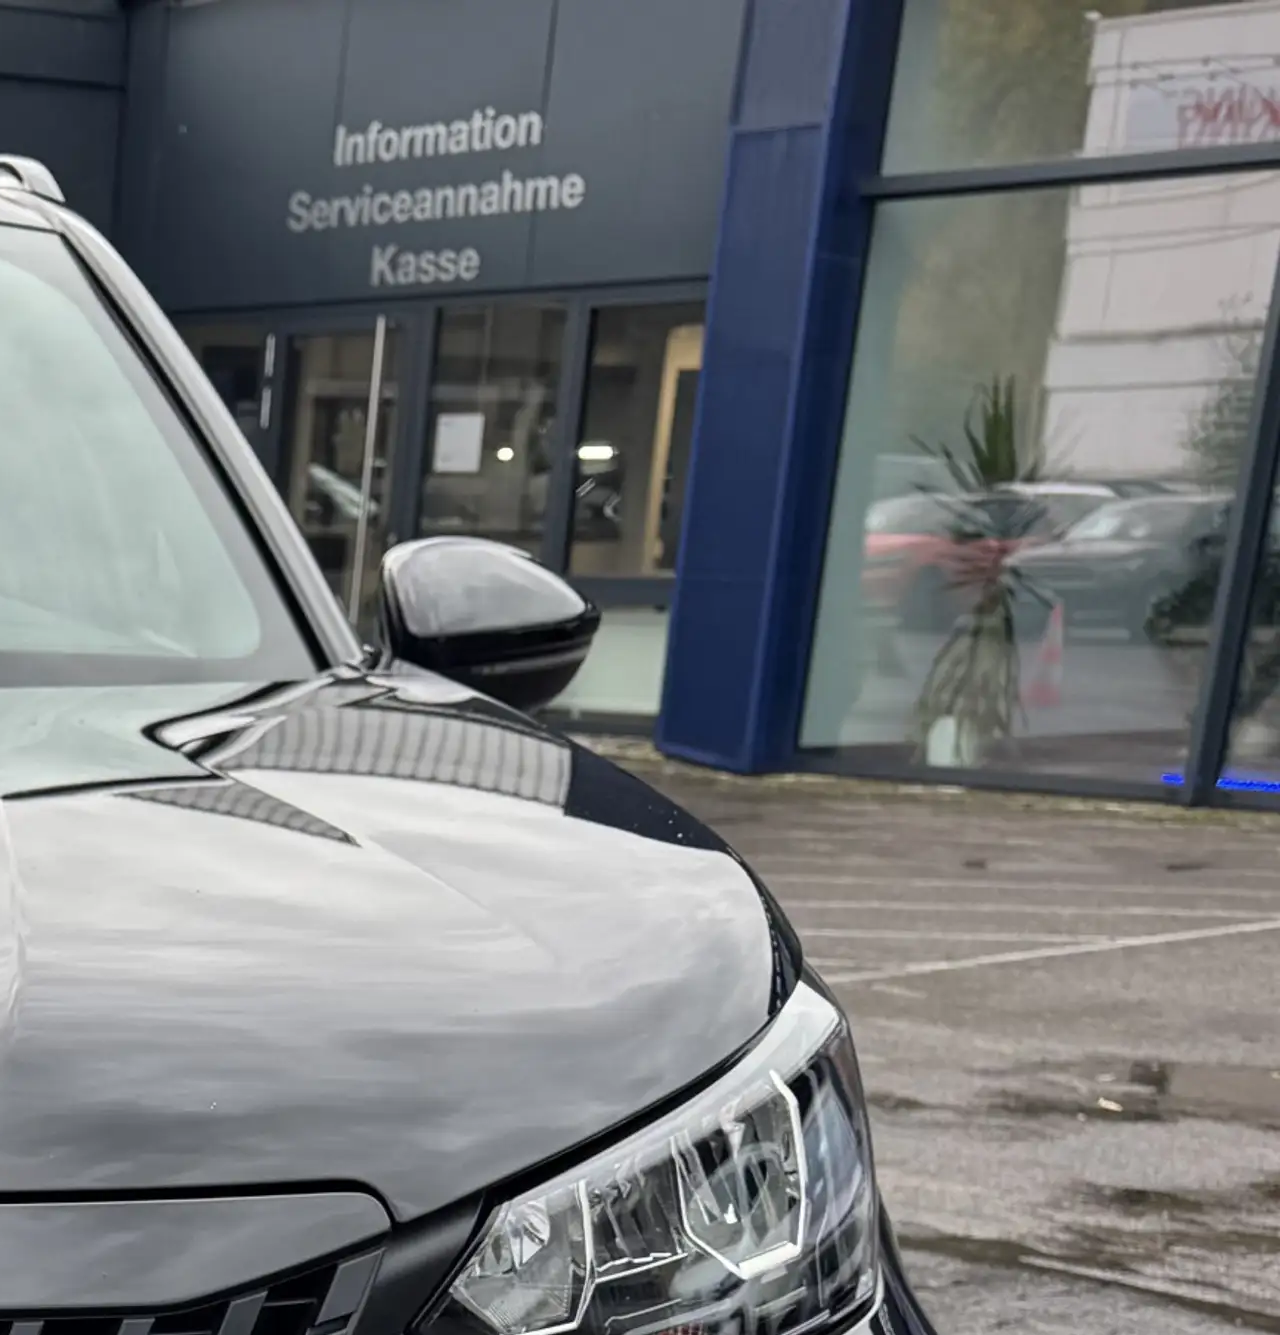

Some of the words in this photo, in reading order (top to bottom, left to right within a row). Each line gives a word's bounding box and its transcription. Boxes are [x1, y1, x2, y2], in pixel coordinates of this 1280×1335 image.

[333, 106, 542, 167] Information
[287, 170, 586, 232] Serviceannahme
[371, 244, 480, 287] Kasse
